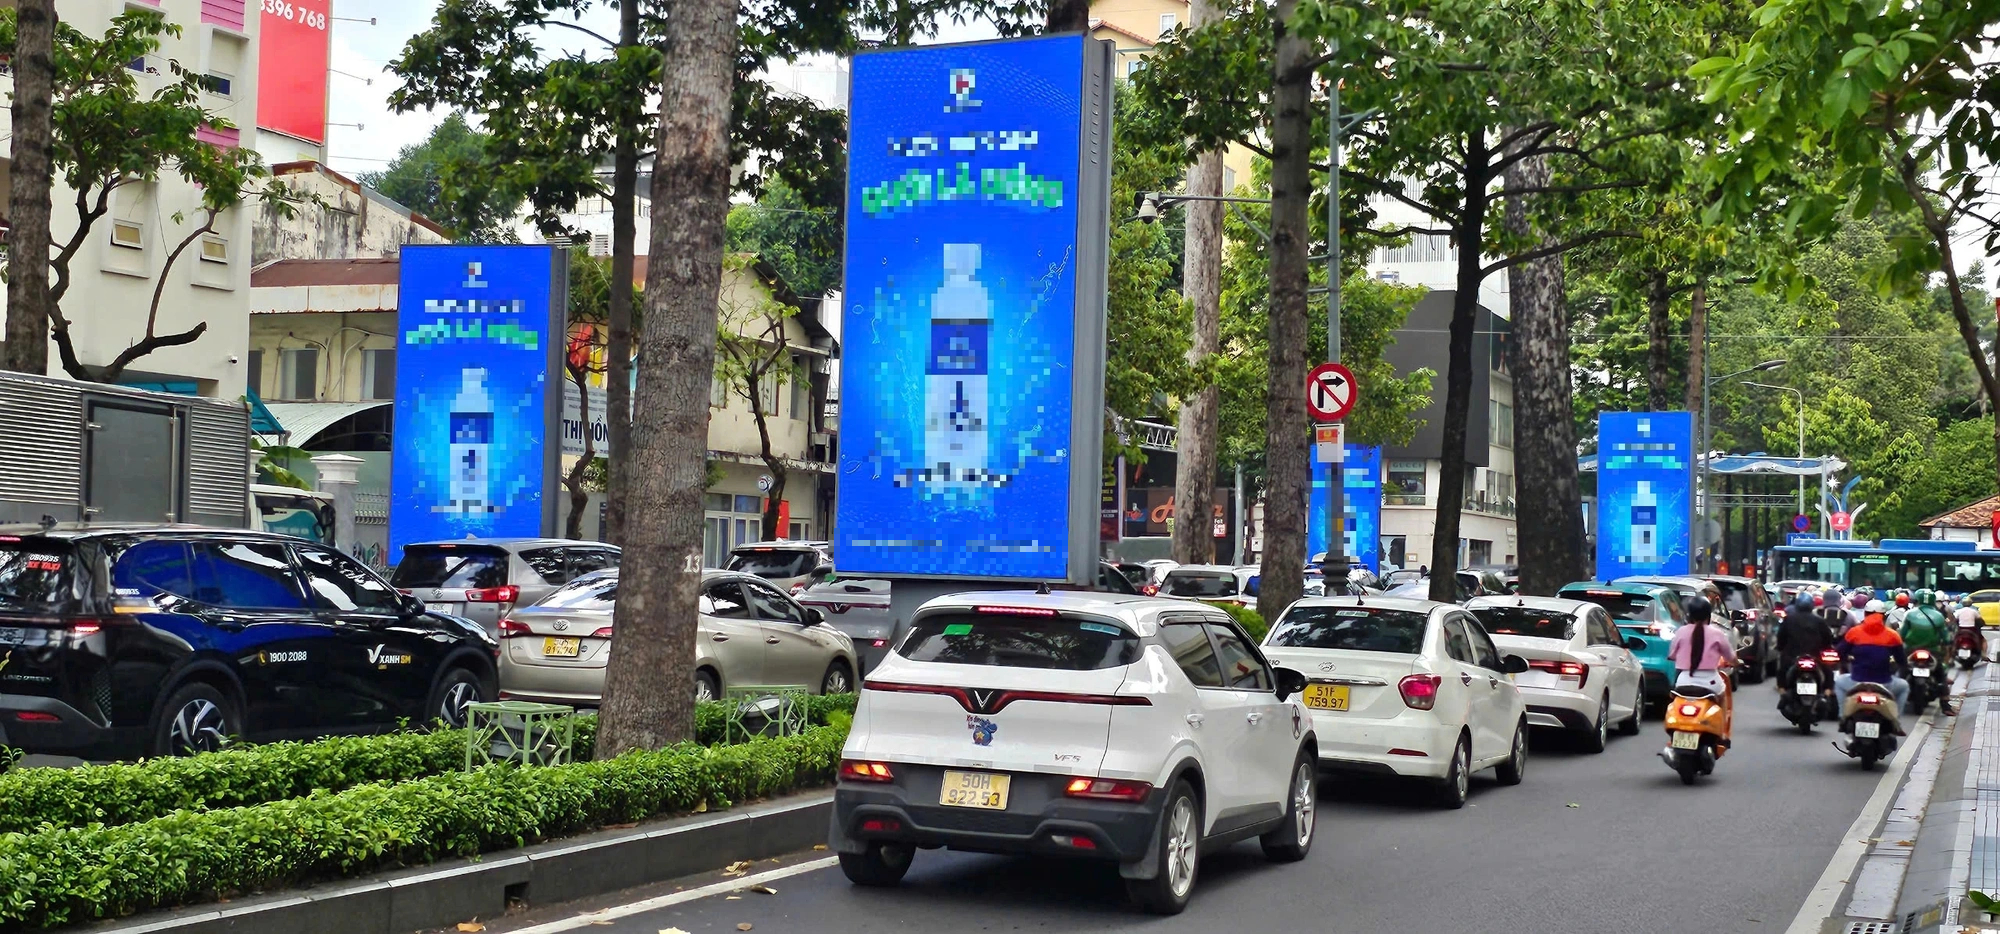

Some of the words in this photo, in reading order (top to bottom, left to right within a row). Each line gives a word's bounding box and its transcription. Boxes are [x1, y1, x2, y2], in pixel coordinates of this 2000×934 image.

[298, 7, 325, 30] 768
[270, 652, 287, 663] 1900
[288, 651, 307, 662] 2088
[380, 655, 400, 664] XANH
[1308, 697, 1344, 709] 759.97
[961, 773, 991, 790] 50H
[947, 788, 1001, 807] 922.53
